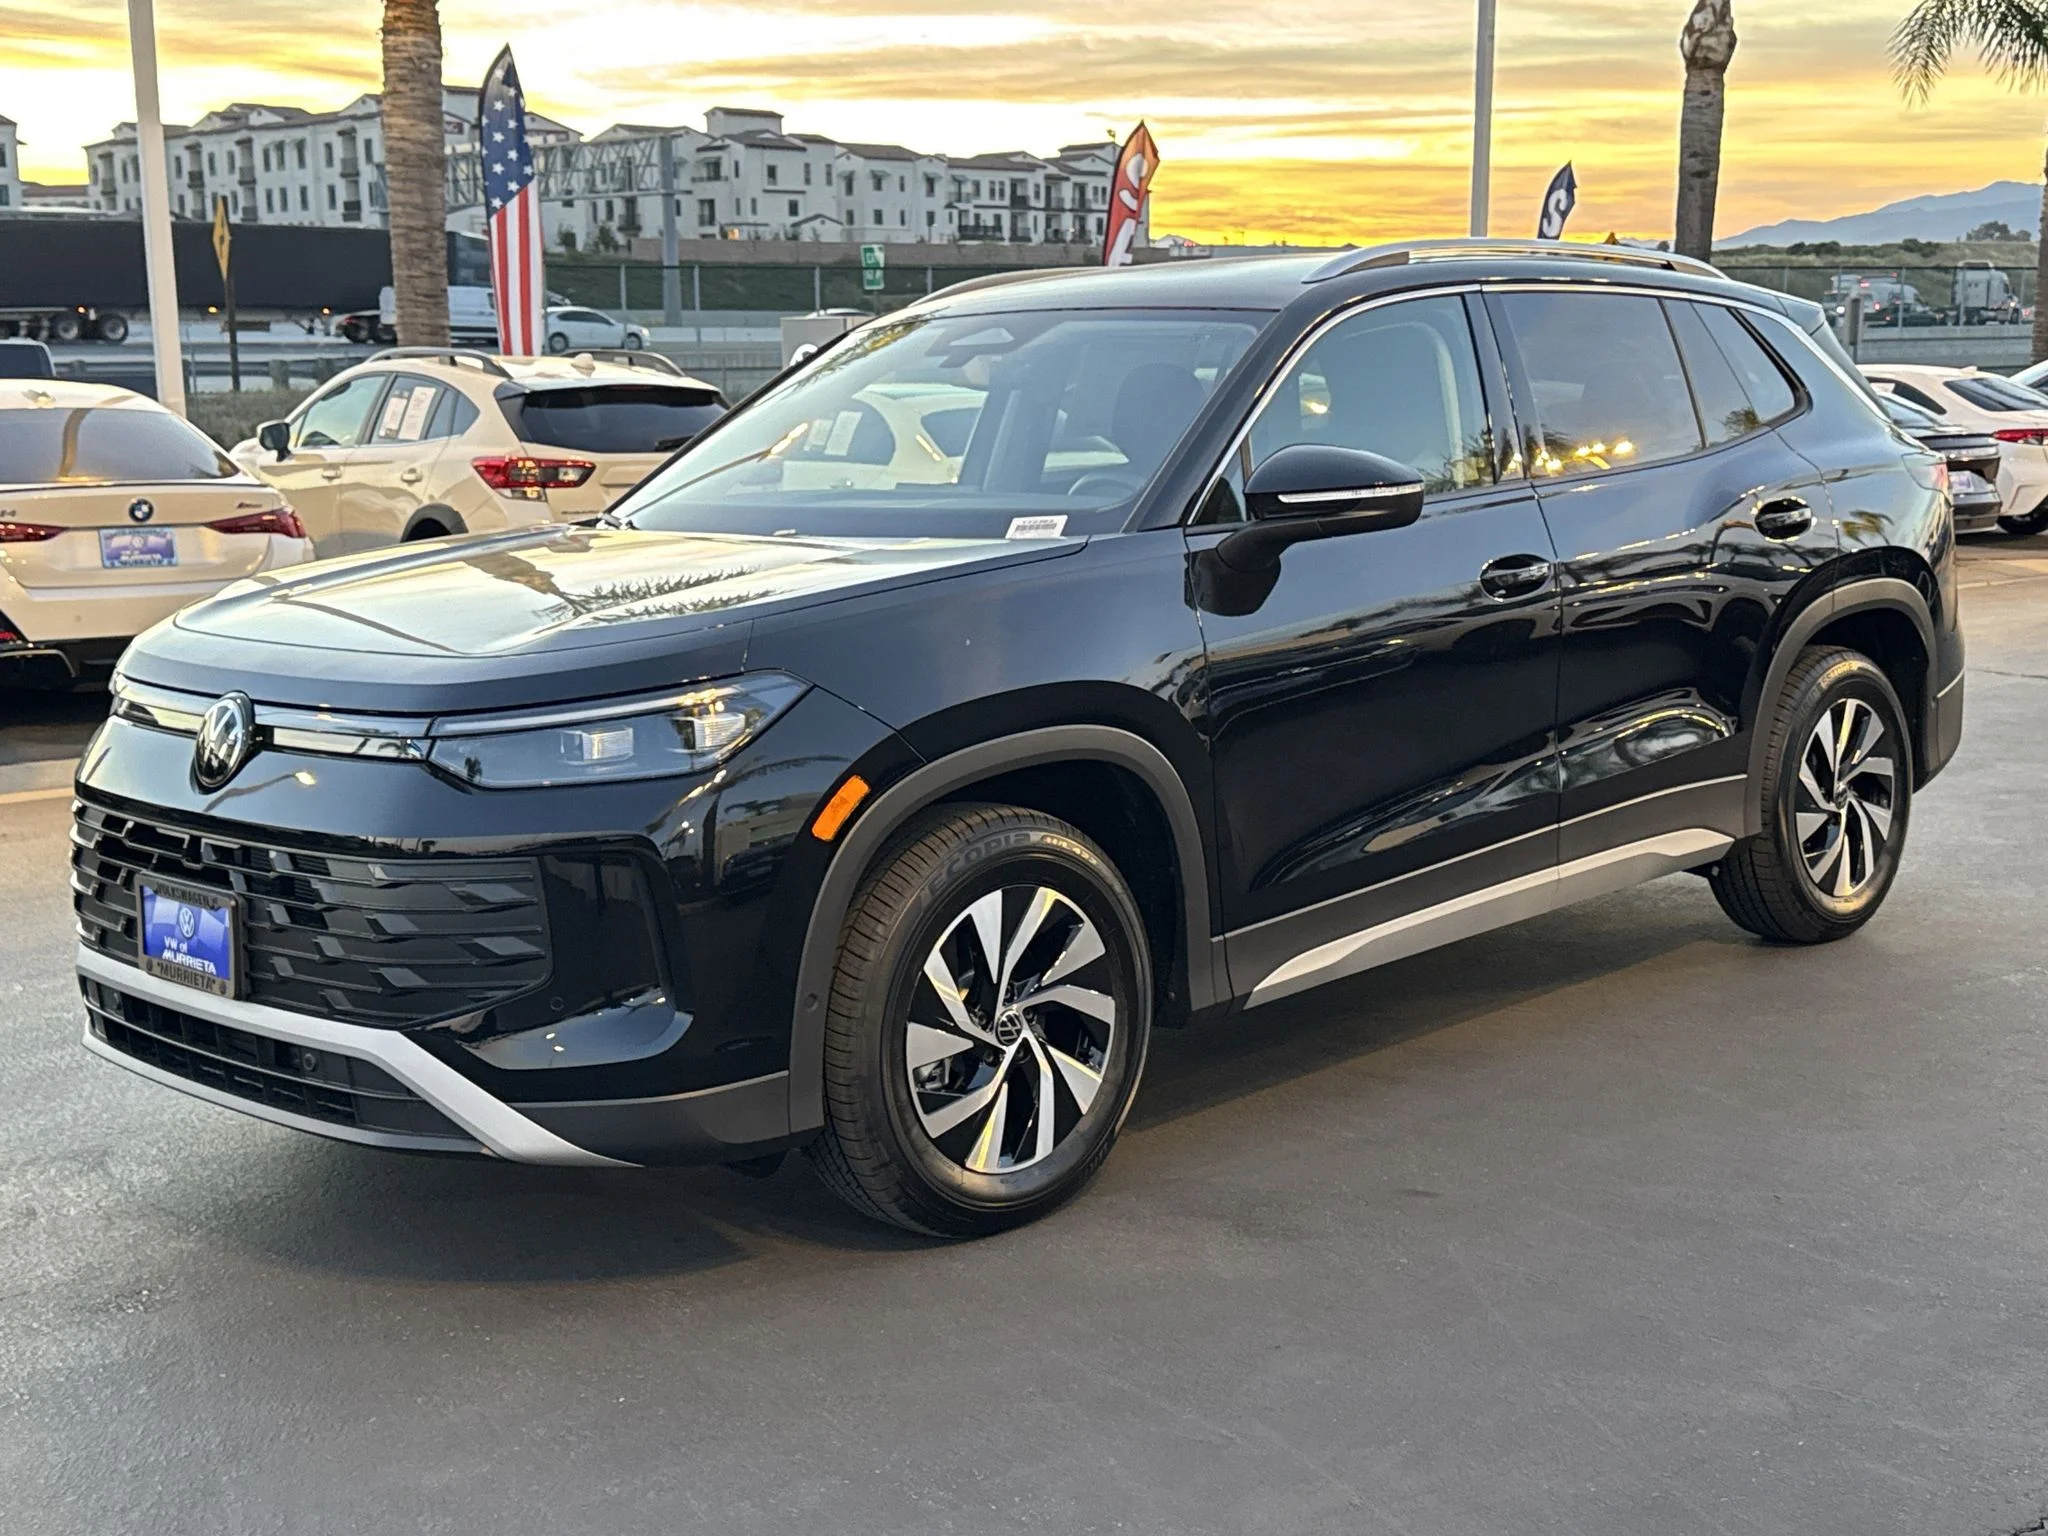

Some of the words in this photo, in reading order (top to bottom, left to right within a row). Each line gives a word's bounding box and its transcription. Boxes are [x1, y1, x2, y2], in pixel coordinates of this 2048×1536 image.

[929, 832, 1031, 896] ECOPIA
[164, 936, 178, 950] VW
[179, 942, 188, 953] of
[162, 949, 217, 975] MURRIETA
